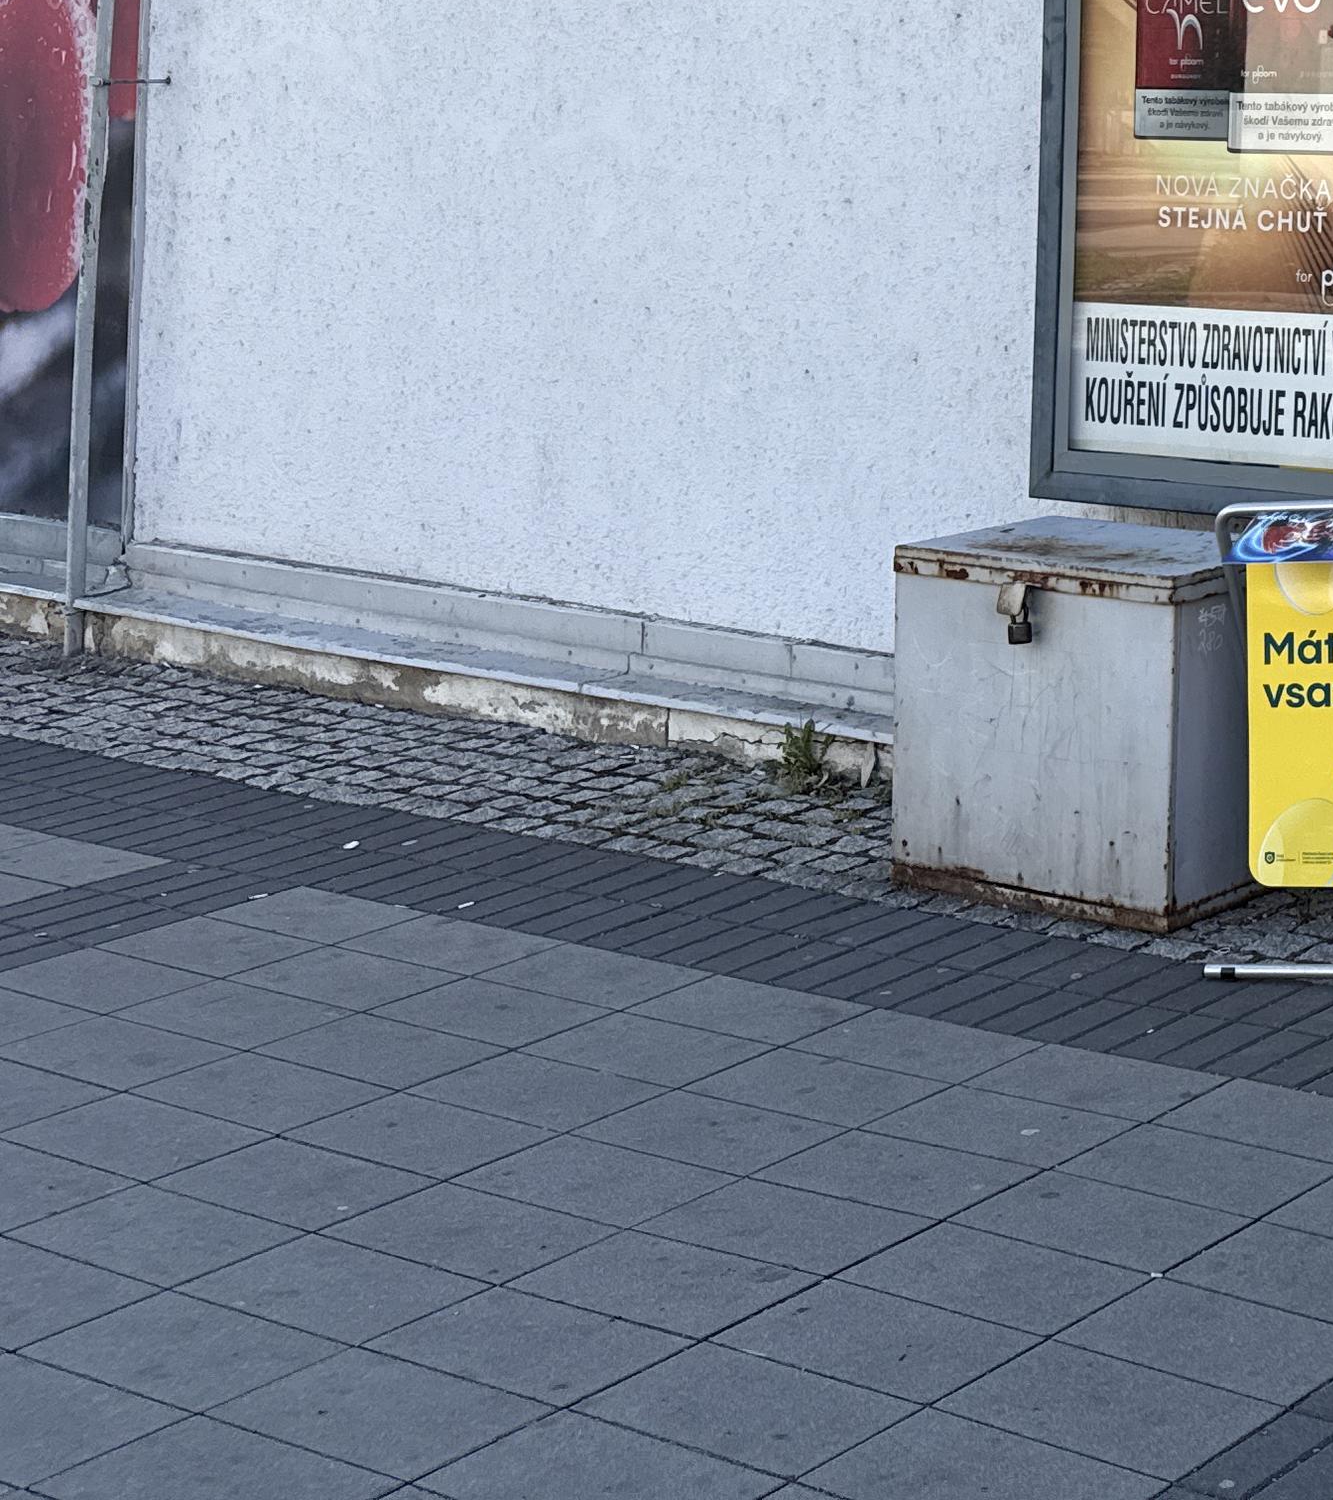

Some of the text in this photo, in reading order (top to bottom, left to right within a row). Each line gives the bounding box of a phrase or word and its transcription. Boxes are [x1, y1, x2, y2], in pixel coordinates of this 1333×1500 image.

[1236, 100, 1263, 111] Tento
[1264, 101, 1309, 114] tabákový
[1243, 115, 1269, 126] škodí
[1271, 115, 1309, 127] Vašemu
[1155, 172, 1332, 201] NOVÁ ZNAČKA
[1157, 203, 1328, 233] STEJNÁ CHUŤ
[1295, 269, 1313, 283] for
[1085, 317, 1197, 369] MINISTERSTVO
[1201, 320, 1329, 377] ZDRAVOTNICTVÍ
[1084, 370, 1170, 428] KOUŘENÍ
[1172, 373, 1287, 437] ZPŮSOBUJE
